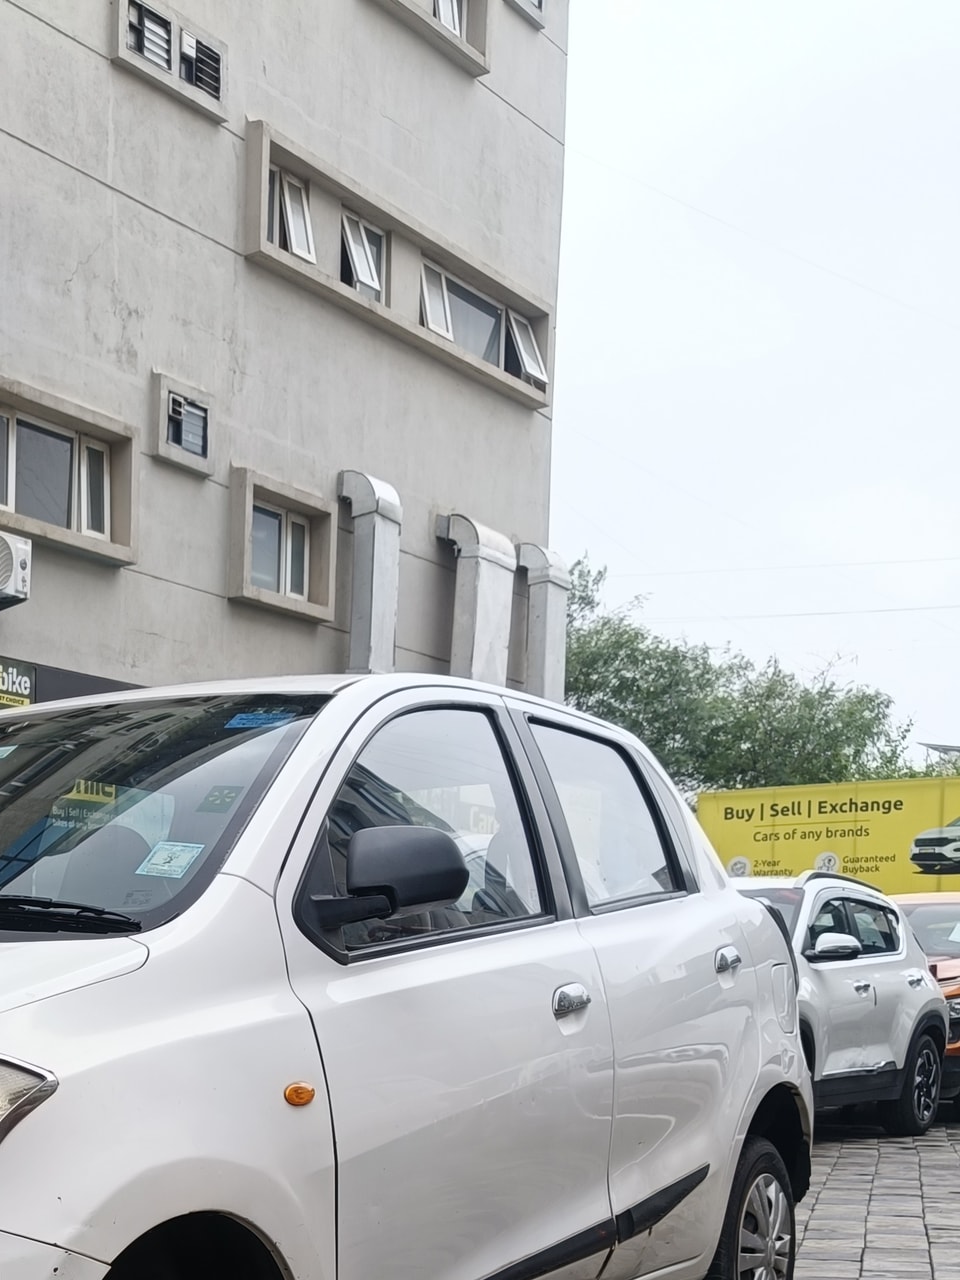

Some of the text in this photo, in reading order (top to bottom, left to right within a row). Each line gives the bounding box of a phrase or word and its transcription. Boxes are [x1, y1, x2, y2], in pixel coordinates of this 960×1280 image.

[724, 806, 755, 822] Buy
[769, 801, 802, 818] Sell
[817, 798, 904, 815] Exchange
[753, 826, 870, 842] Cars of any brands
[753, 859, 781, 868] 2-Year
[842, 855, 896, 864] Guaranteed
[753, 869, 793, 877] Warranty
[842, 865, 880, 876] Buyback
